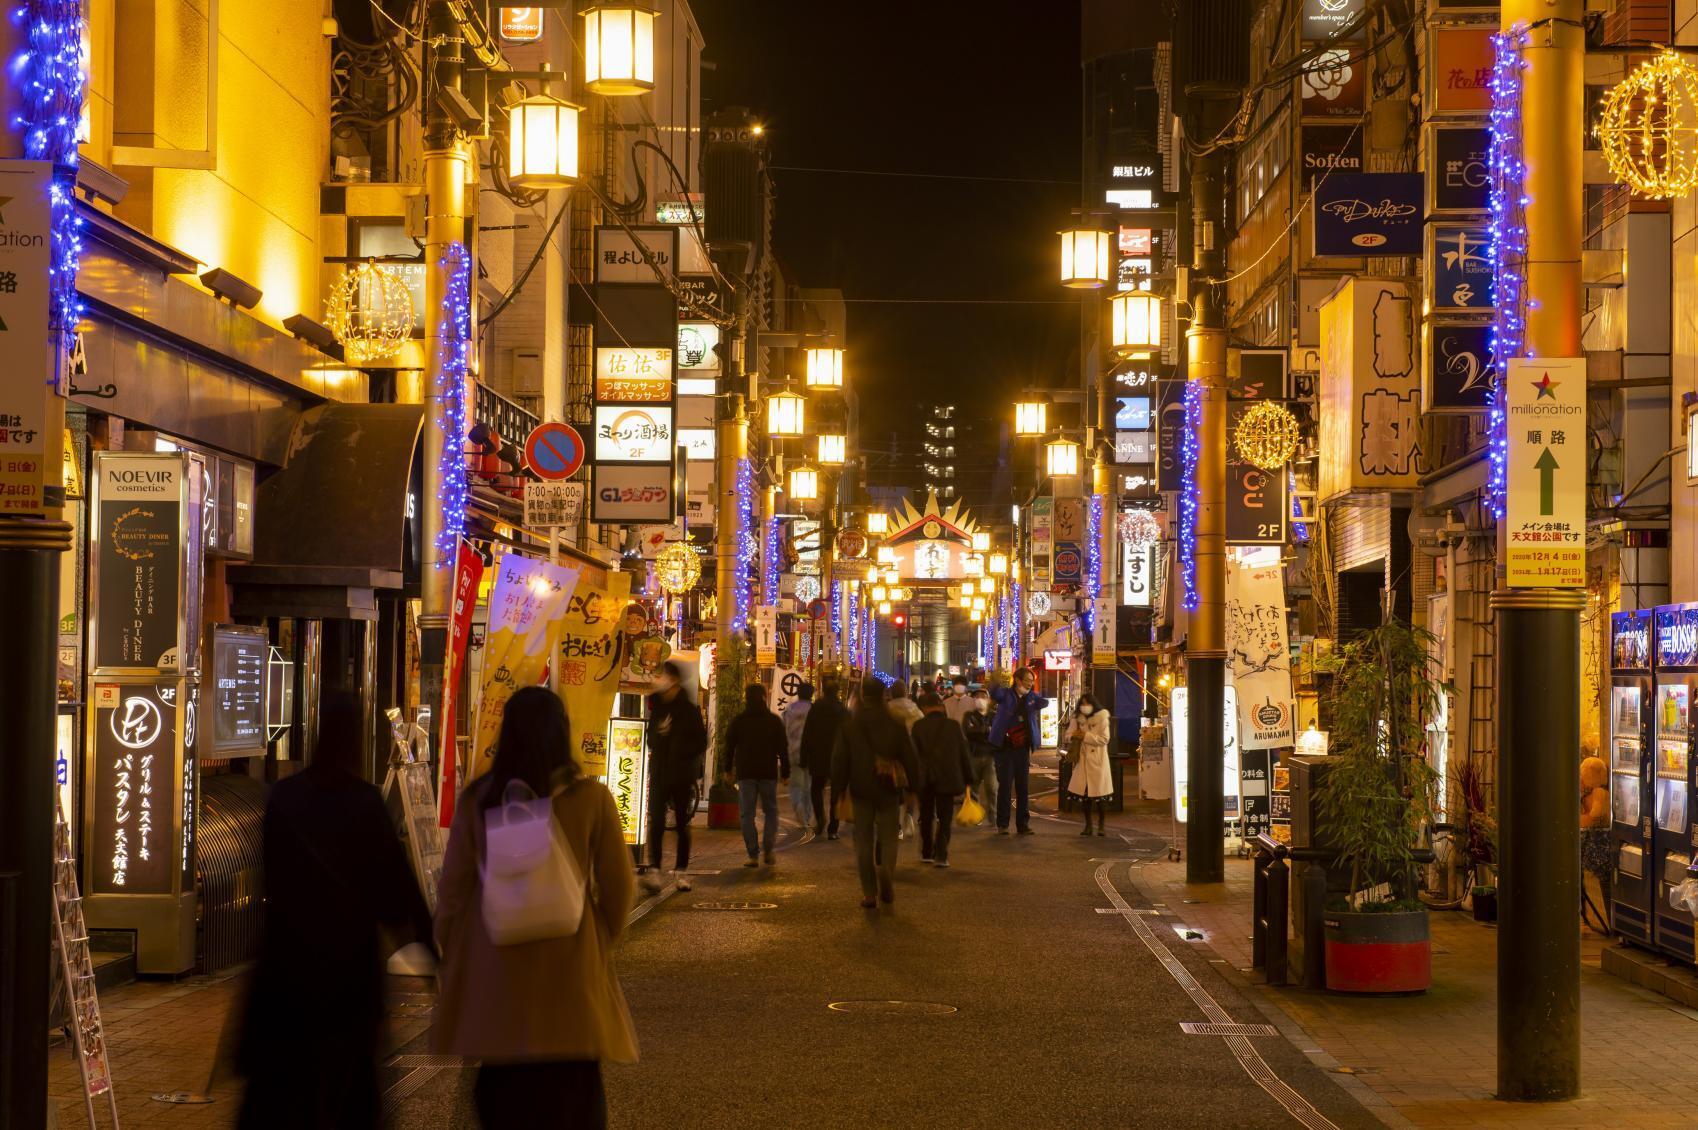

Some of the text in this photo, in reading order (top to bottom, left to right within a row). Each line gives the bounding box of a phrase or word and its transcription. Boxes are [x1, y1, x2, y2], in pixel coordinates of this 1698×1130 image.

[1305, 153, 1360, 168] Soften
[1112, 166, 1154, 177] 銀星ビル
[1362, 236, 1378, 244] 2F
[656, 350, 671, 361] 3F
[605, 382, 666, 391] つぼマッサージ
[600, 391, 670, 400] オイルマッサージ
[1511, 404, 1582, 415] millionation
[598, 424, 669, 440] まつり酒場
[1527, 430, 1566, 445] 順路
[629, 448, 645, 458] 2F
[109, 470, 172, 483] NOEVIR
[116, 484, 166, 492] cosmetics
[1257, 524, 1280, 538] 2F
[1522, 522, 1571, 532] メイン会場は
[1512, 532, 1581, 542] 天文館公園です
[132, 566, 144, 661] BEAUTY DINER
[60, 620, 74, 632] 3F
[1671, 624, 1691, 654] BOSS
[62, 652, 74, 662] 2F
[163, 655, 177, 665] 3F
[162, 688, 176, 700] 2F
